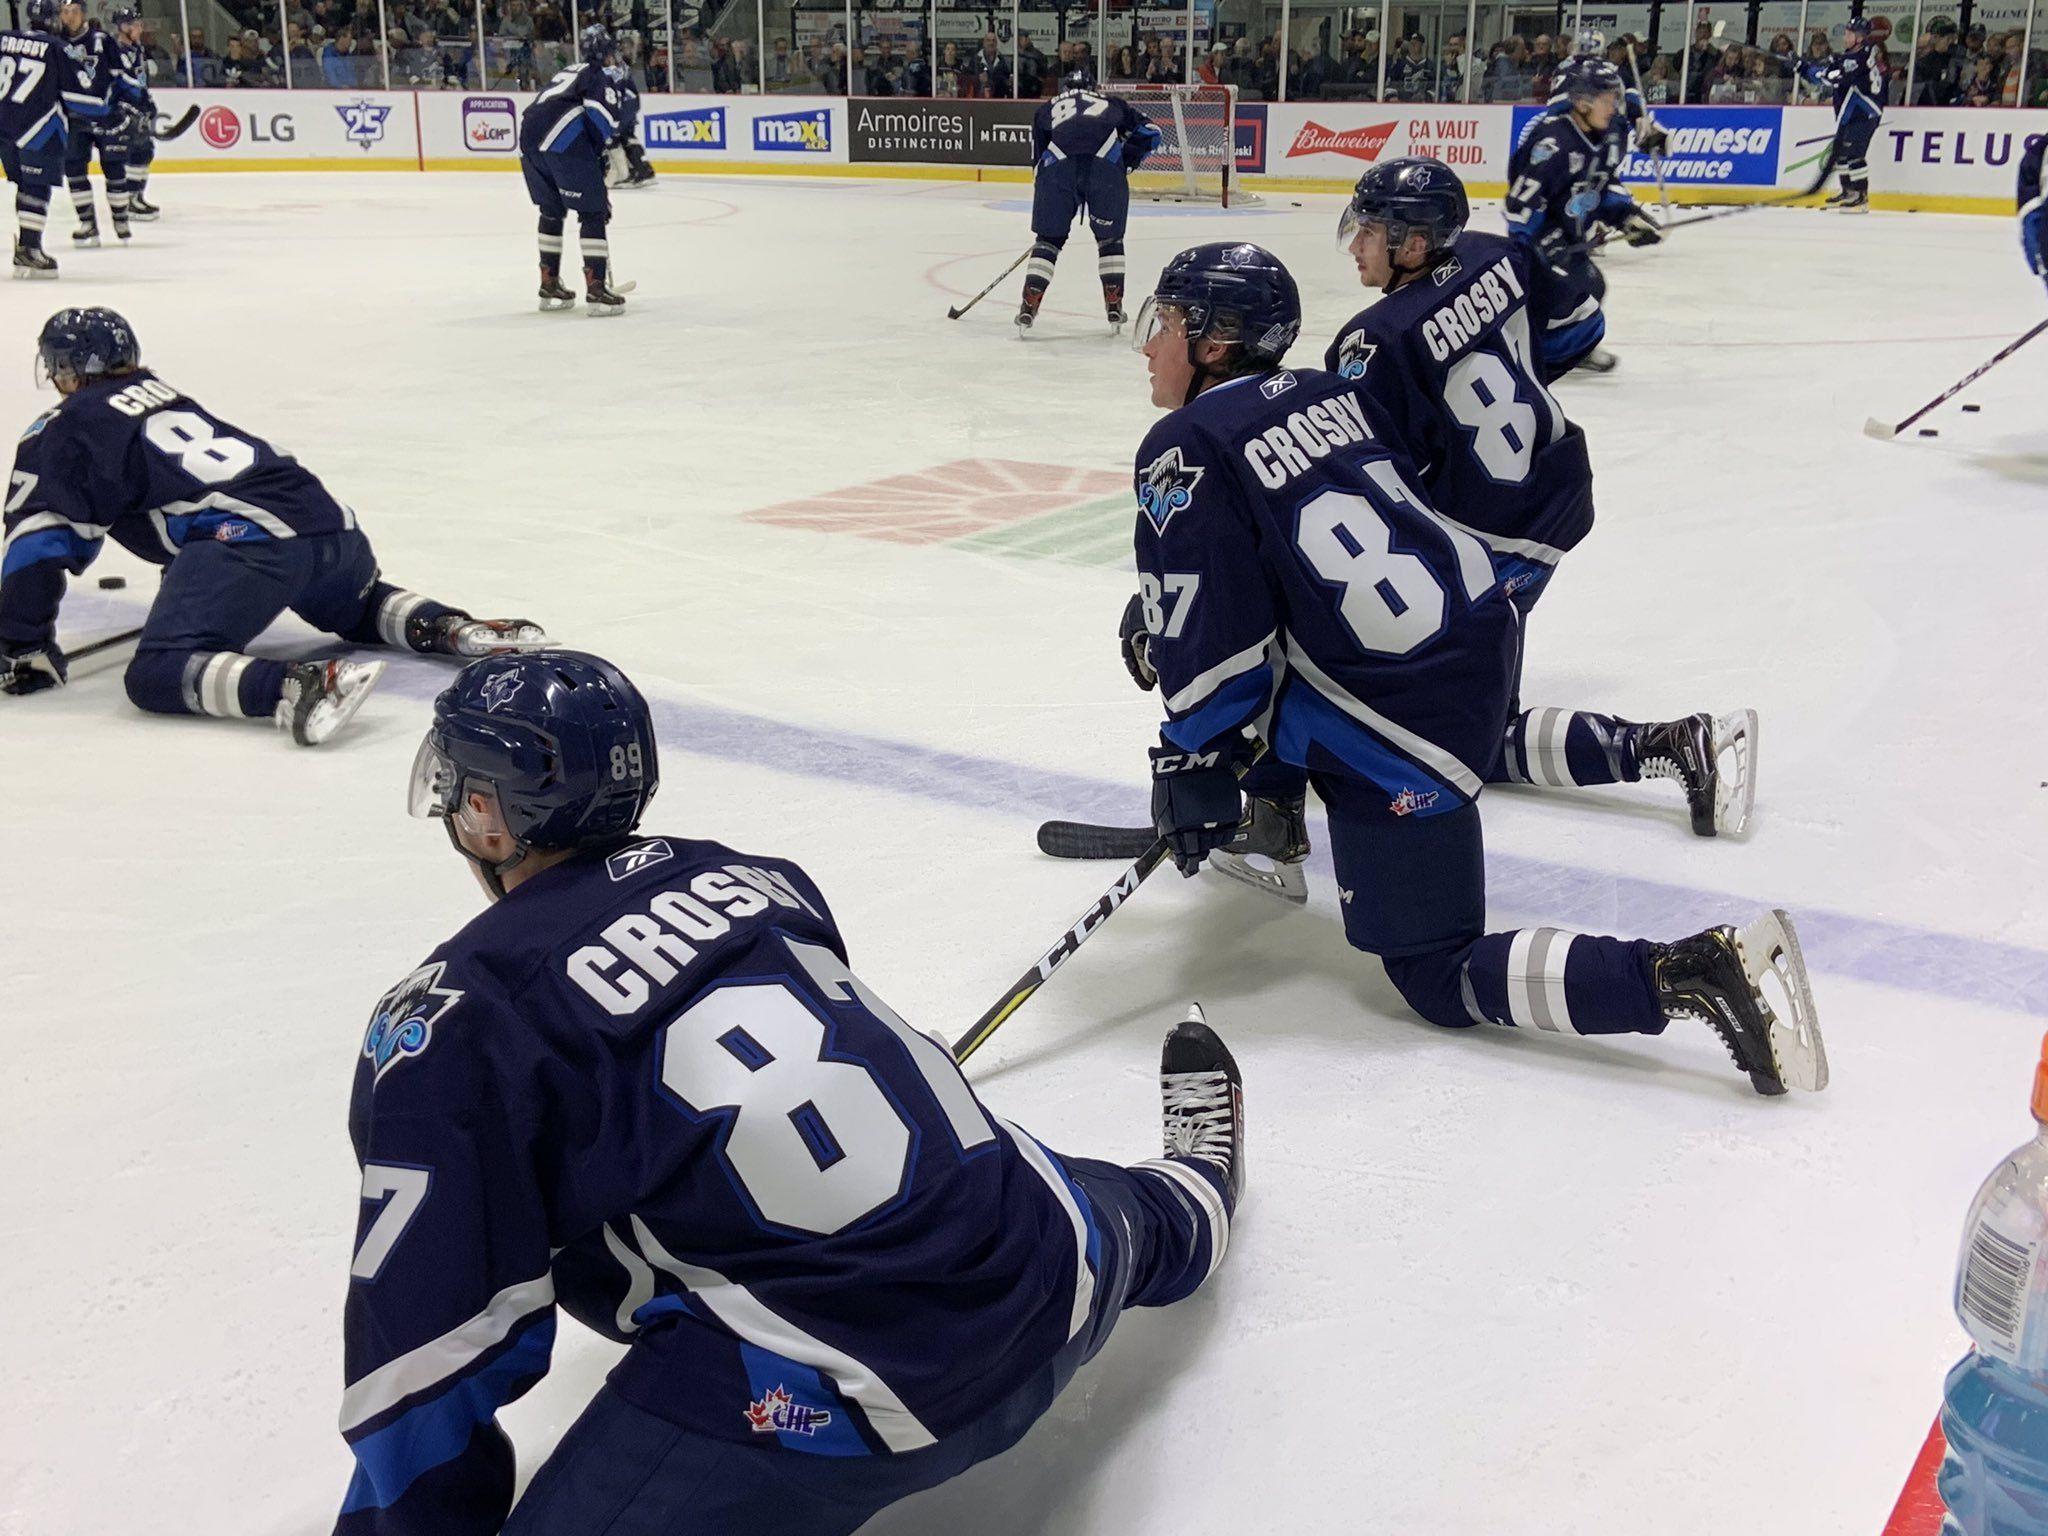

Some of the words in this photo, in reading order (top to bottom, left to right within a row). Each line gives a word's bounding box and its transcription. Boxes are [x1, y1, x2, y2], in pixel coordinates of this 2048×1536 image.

[250, 113, 296, 142] LG
[346, 108, 384, 140] 25
[650, 111, 721, 142] maxi
[758, 112, 826, 143] maxi
[857, 107, 964, 133] Armoires
[980, 130, 1032, 143] MIRALI
[1433, 119, 1480, 140] VAUT
[868, 137, 963, 150] DISTINCTION
[1295, 126, 1388, 150] Budweiser
[1447, 144, 1487, 164] BUD.
[1614, 157, 1733, 179] Assurance
[1421, 256, 1525, 363] CROSBY
[108, 379, 178, 417] CRO
[1442, 303, 1567, 484] 87
[1244, 390, 1376, 491] CROSBY
[1296, 458, 1497, 656] 87
[1140, 572, 1200, 639] 87
[609, 743, 642, 782] 89
[566, 863, 824, 1016] CROSBY
[1036, 865, 1141, 981] CCM
[661, 936, 997, 1237] 87
[771, 1402, 816, 1436] CHL
